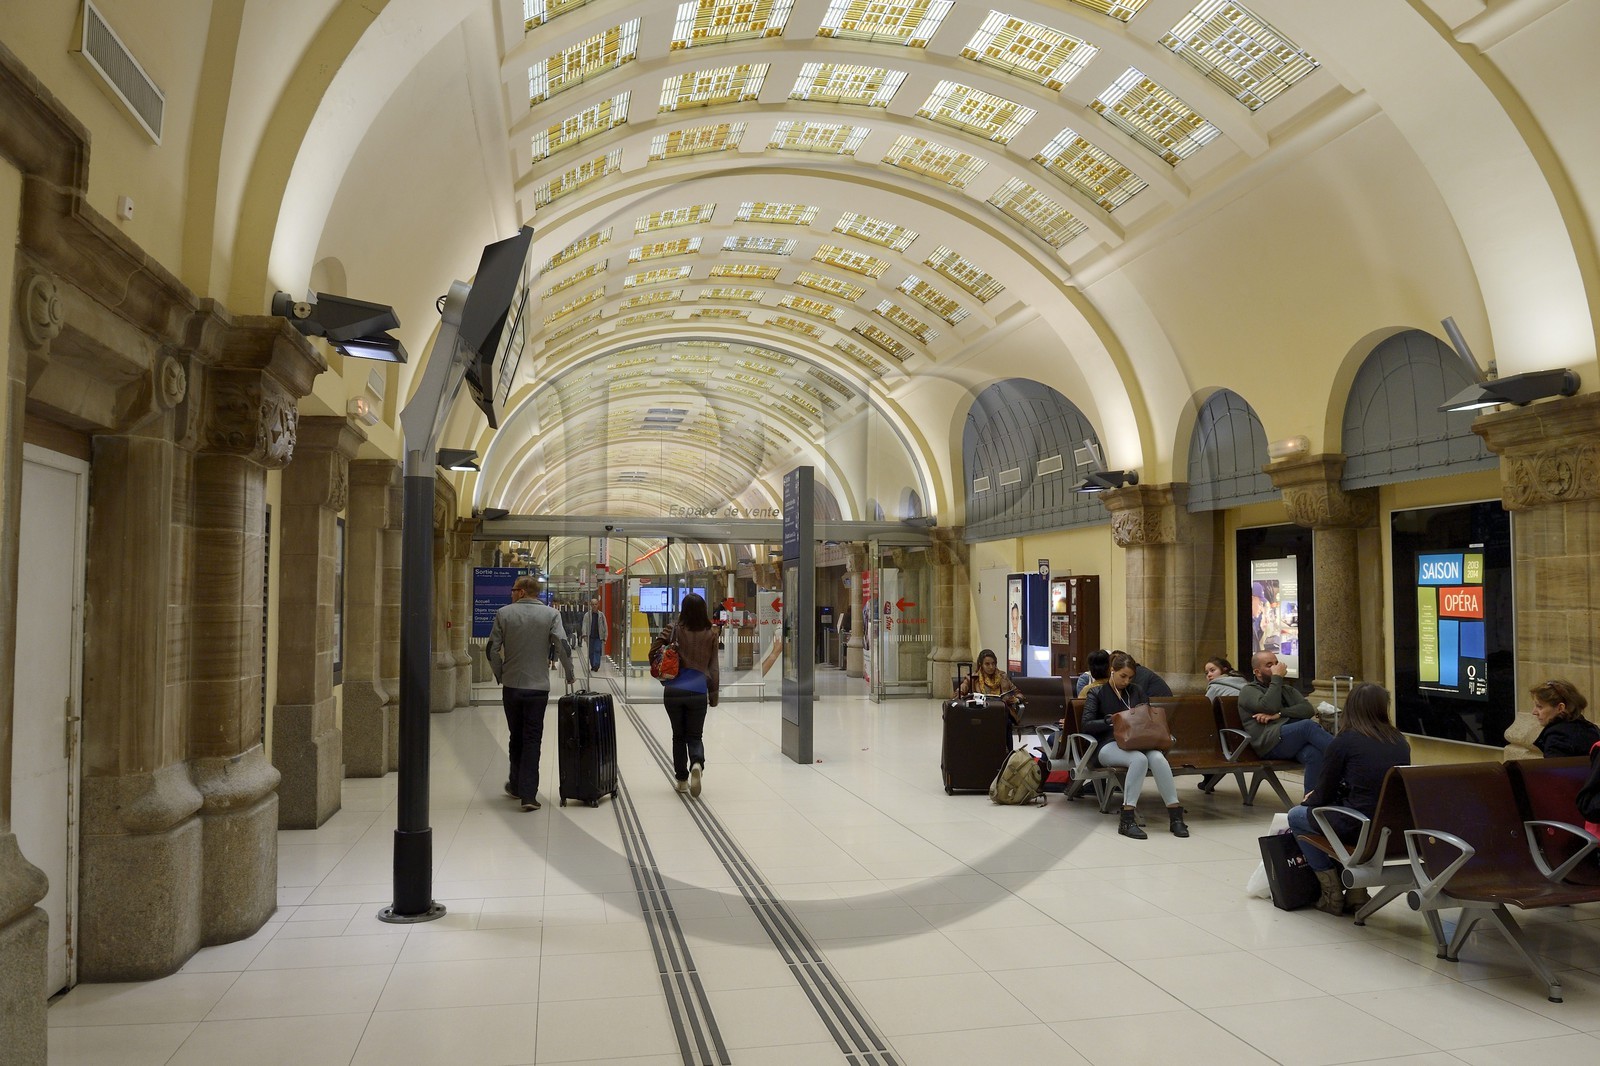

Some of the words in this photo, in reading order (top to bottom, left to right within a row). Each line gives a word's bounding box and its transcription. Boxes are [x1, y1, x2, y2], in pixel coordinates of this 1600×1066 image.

[669, 504, 717, 519] Espace
[724, 506, 738, 517] de
[745, 507, 779, 517] vente
[1422, 562, 1459, 579] SAISON
[1467, 561, 1479, 569] 2013
[1467, 570, 1479, 578] 2014
[1444, 590, 1479, 612] OPÉRA
